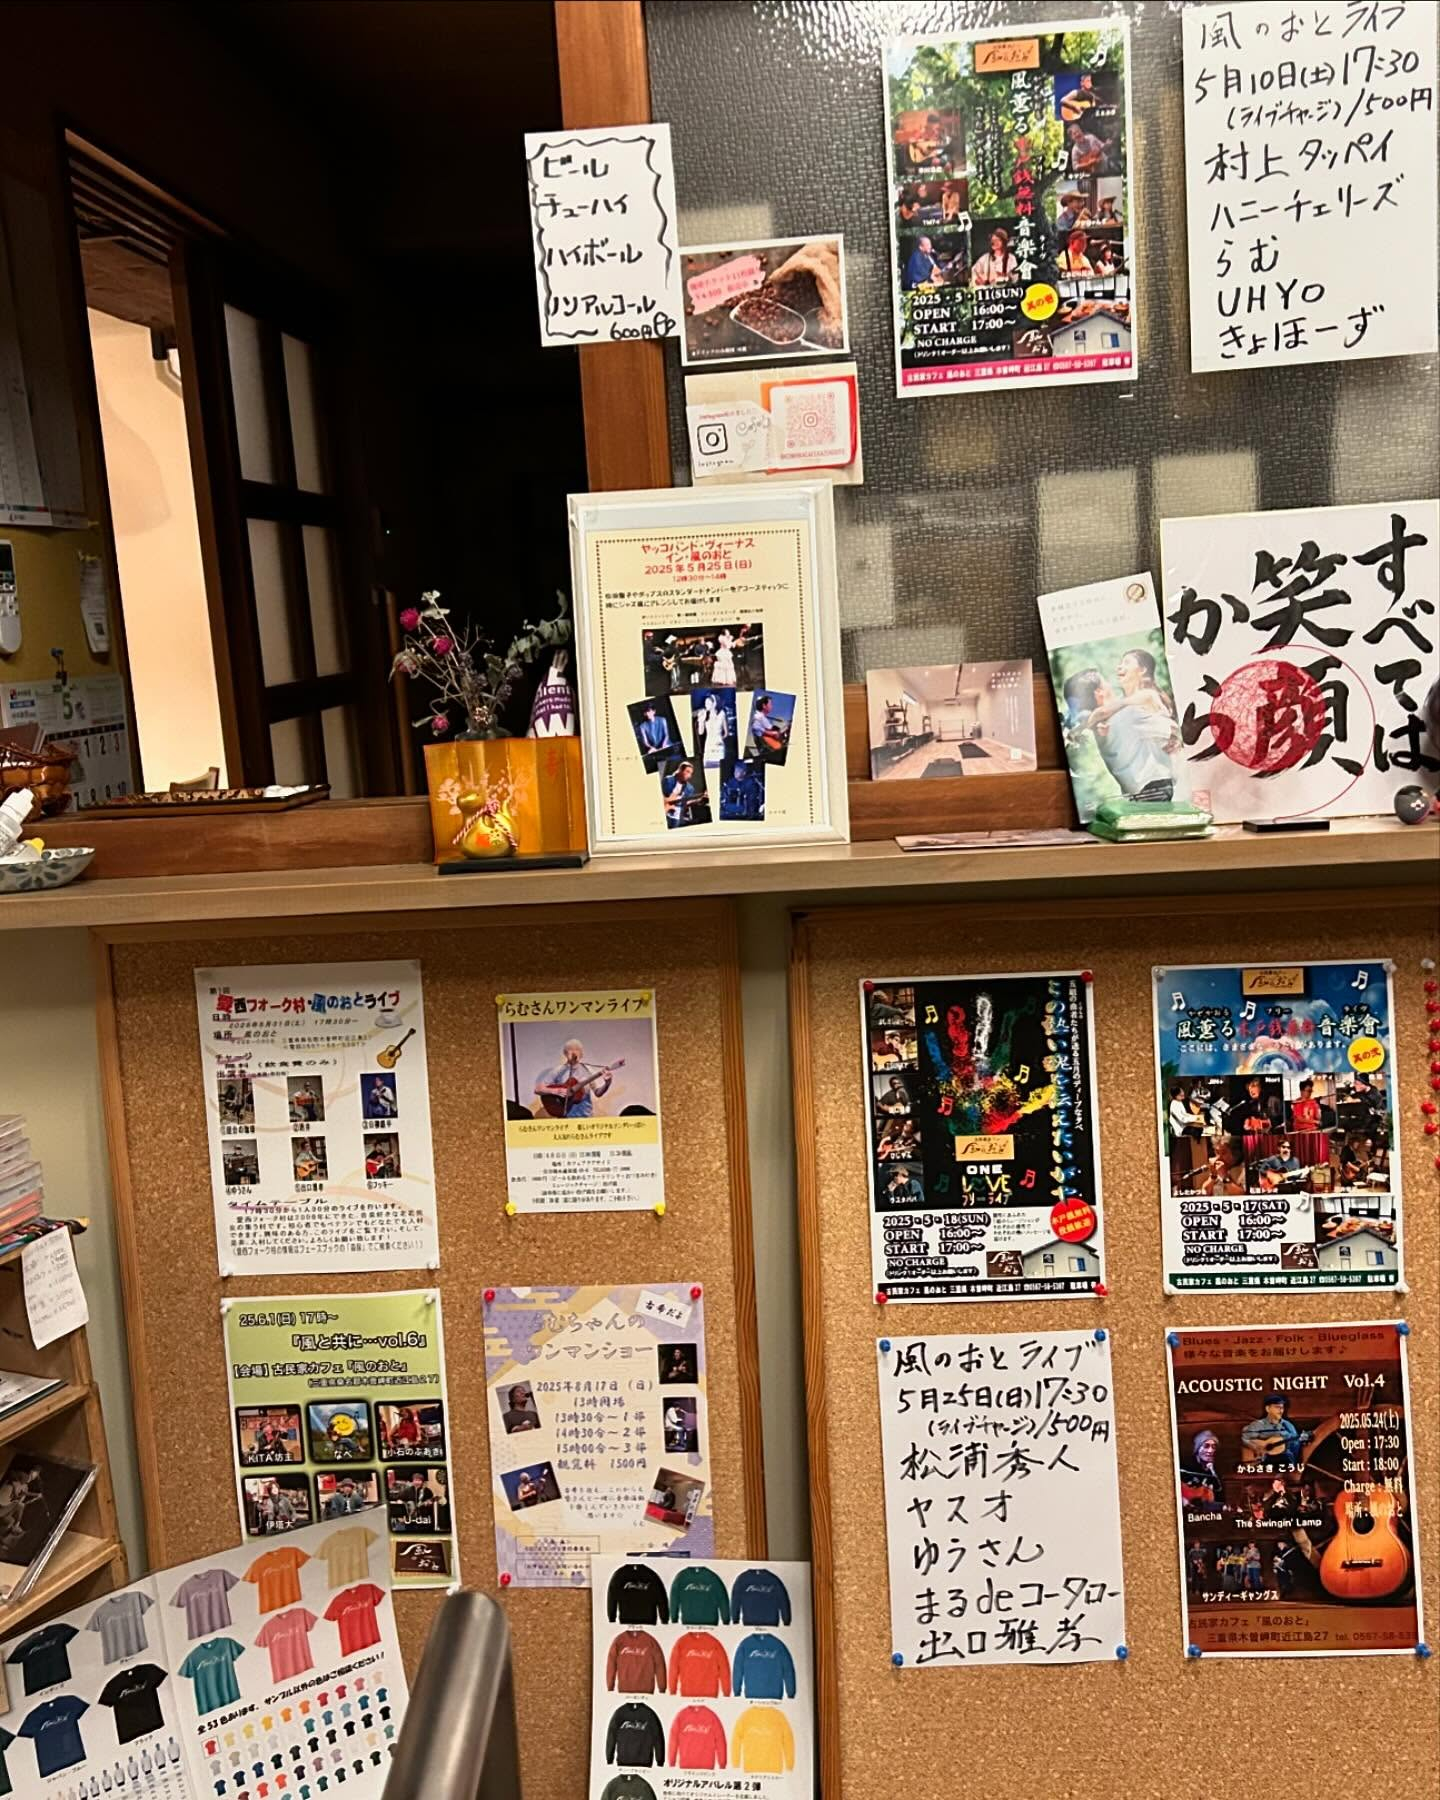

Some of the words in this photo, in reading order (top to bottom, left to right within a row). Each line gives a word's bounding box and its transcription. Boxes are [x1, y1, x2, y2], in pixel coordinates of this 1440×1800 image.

[1201, 11, 1332, 49] 風のおと
[543, 154, 609, 178] ビール
[539, 194, 629, 218] チューハイ
[1211, 173, 1404, 231] ハニーチェリーズ
[547, 238, 643, 267] ハイボール
[1217, 236, 1279, 277] らむ
[1218, 279, 1325, 318] UHYO
[914, 308, 951, 321] OPEN
[914, 322, 957, 335] START
[1220, 305, 1384, 358] きょほーず
[917, 339, 932, 348] NO
[933, 336, 977, 347] CHARGE
[1352, 513, 1440, 772] すべては
[1249, 540, 1364, 779] 笑顔
[966, 1164, 1003, 1174] ONE
[1183, 1215, 1219, 1227] OPEN
[885, 1229, 921, 1242] OPEN
[1183, 1230, 1225, 1241] START
[885, 1242, 928, 1255] START
[1186, 1246, 1202, 1254] NO
[1203, 1245, 1244, 1253] CHARGE
[888, 1260, 904, 1268] NO
[905, 1258, 946, 1267] CHARGE
[1232, 1337, 1264, 1345] Jazz
[1276, 1334, 1305, 1344] Folk
[894, 1342, 1009, 1376] 風のおと
[1020, 1339, 1097, 1371] ライブ
[1177, 1378, 1263, 1395] ACOUSTIC
[1273, 1375, 1329, 1391] NIGHT
[1344, 1373, 1386, 1389] Vol.4
[1341, 1437, 1366, 1453] Open
[1374, 1437, 1400, 1449] 17:30
[900, 1440, 1080, 1482] 松浦秀人
[1237, 1464, 1273, 1474] かわさき
[1342, 1458, 1365, 1471] Start
[1374, 1457, 1399, 1471] 18:00
[1344, 1479, 1376, 1496] Charge
[907, 1490, 1012, 1529] ヤスオ
[1188, 1512, 1222, 1522] Bancha
[1235, 1519, 1253, 1529] The
[1296, 1517, 1323, 1529] Lamp
[914, 1536, 1044, 1576] ゆうさん
